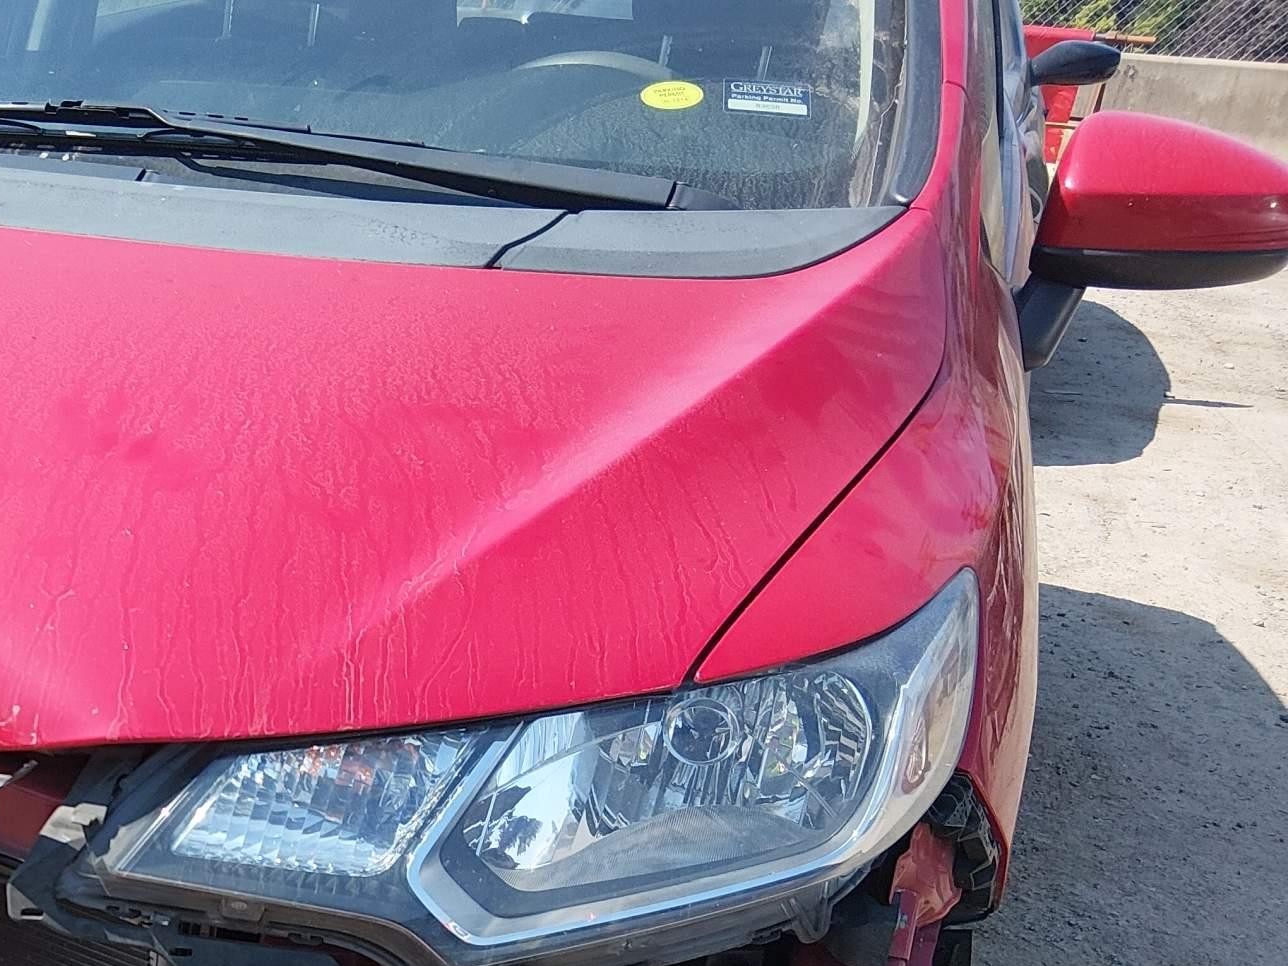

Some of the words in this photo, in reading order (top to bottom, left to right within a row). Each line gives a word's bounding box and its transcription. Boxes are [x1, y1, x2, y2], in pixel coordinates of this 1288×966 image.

[730, 81, 803, 98] GREYSTAR
[731, 93, 762, 101] Parking
[763, 95, 789, 103] Permit
